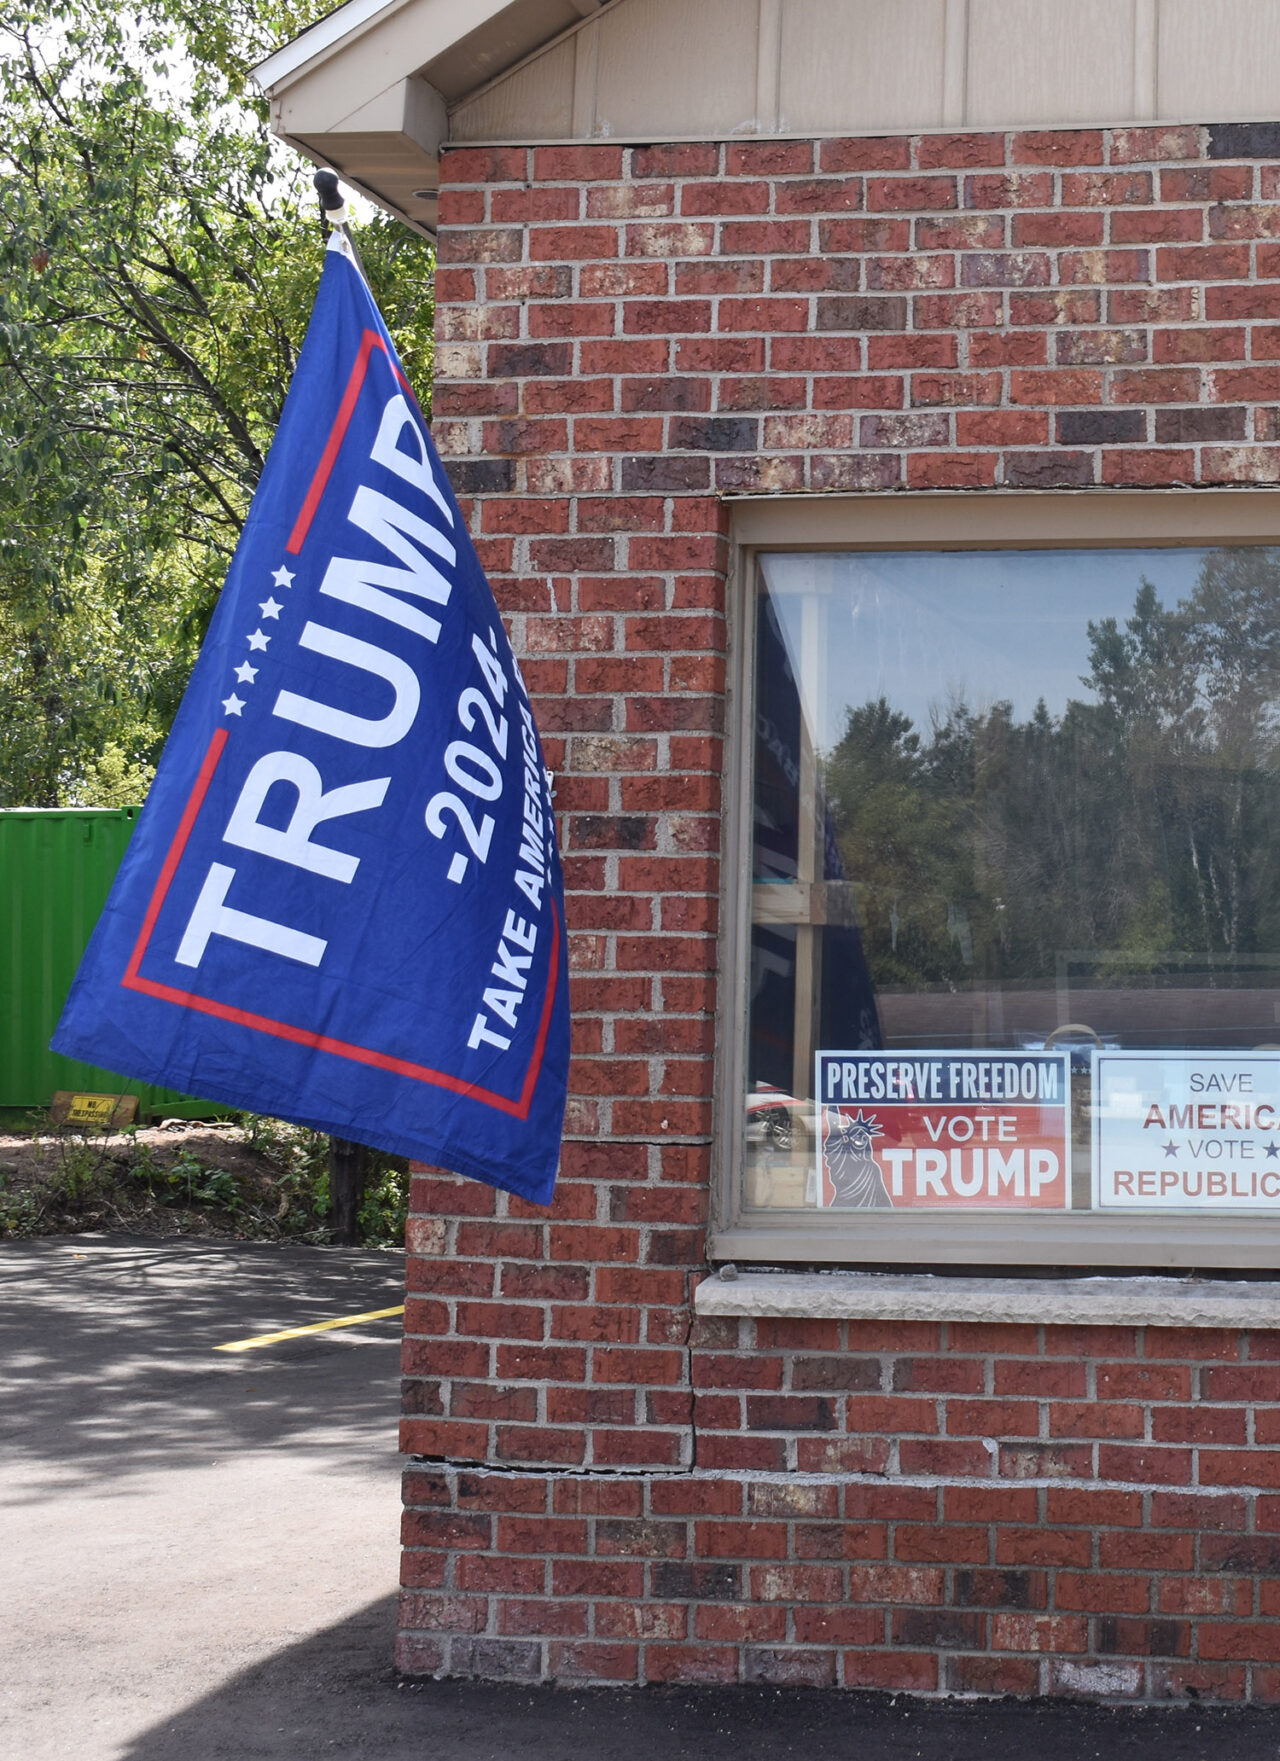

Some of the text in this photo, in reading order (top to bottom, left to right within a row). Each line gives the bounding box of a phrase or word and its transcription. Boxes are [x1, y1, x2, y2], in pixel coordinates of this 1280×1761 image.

[175, 394, 456, 968] TRUMP
[467, 908, 537, 1050] TAKE
[514, 701, 546, 911] AMERICA
[827, 1061, 1058, 1099] PRESERVE FREEDOM
[1190, 1073, 1254, 1093] SAVE
[923, 1115, 1018, 1142] VOTE
[1188, 1139, 1255, 1159] VOTE
[882, 1148, 1060, 1197] TRUMP
